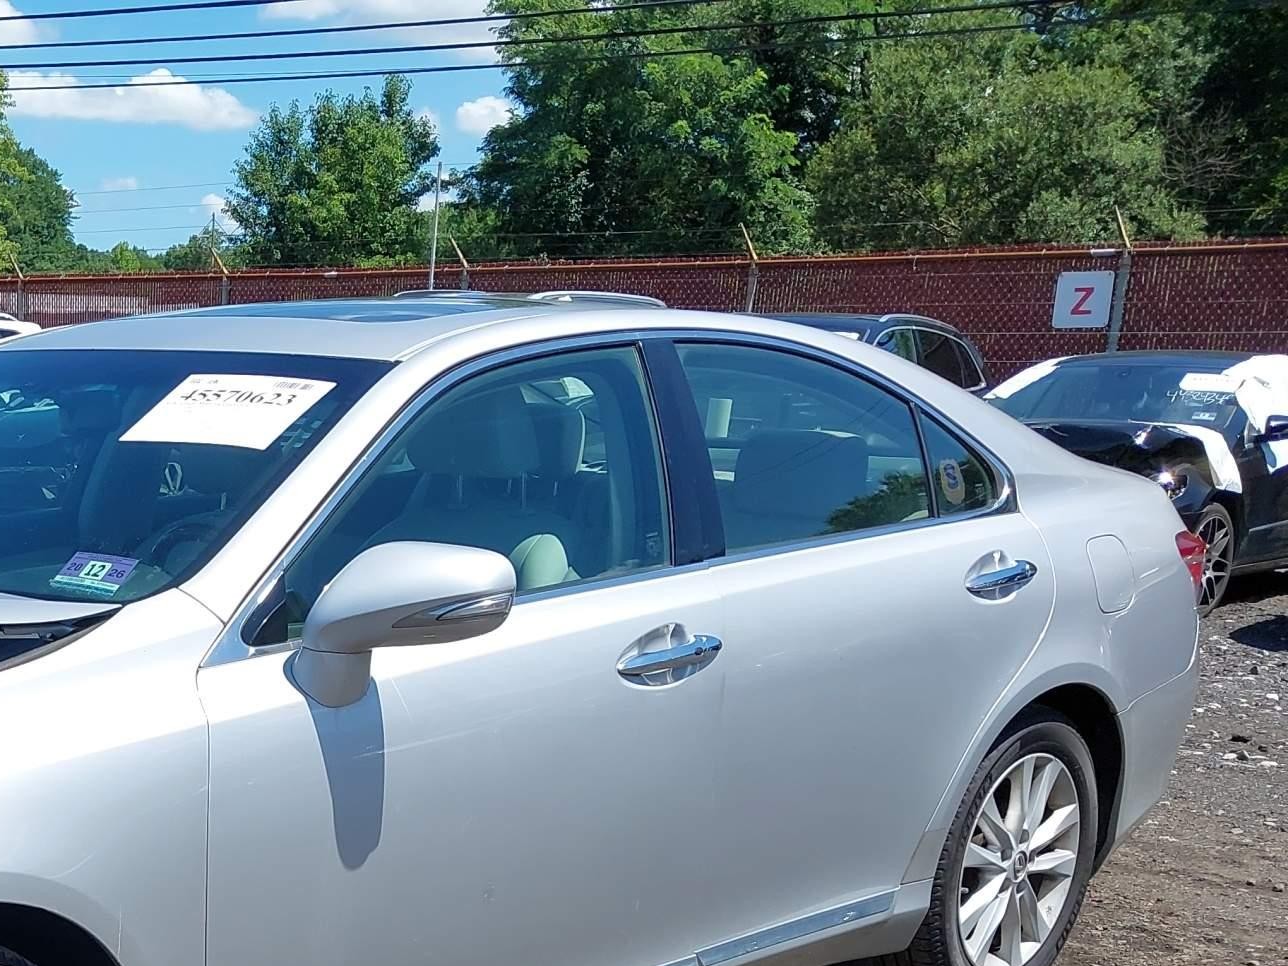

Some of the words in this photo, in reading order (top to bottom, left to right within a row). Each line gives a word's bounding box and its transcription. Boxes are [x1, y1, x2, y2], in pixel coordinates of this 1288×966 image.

[1070, 286, 1095, 316] Z
[180, 389, 297, 407] 45570623
[66, 562, 82, 572] 20
[84, 563, 107, 578] 12
[107, 568, 125, 579] 26
